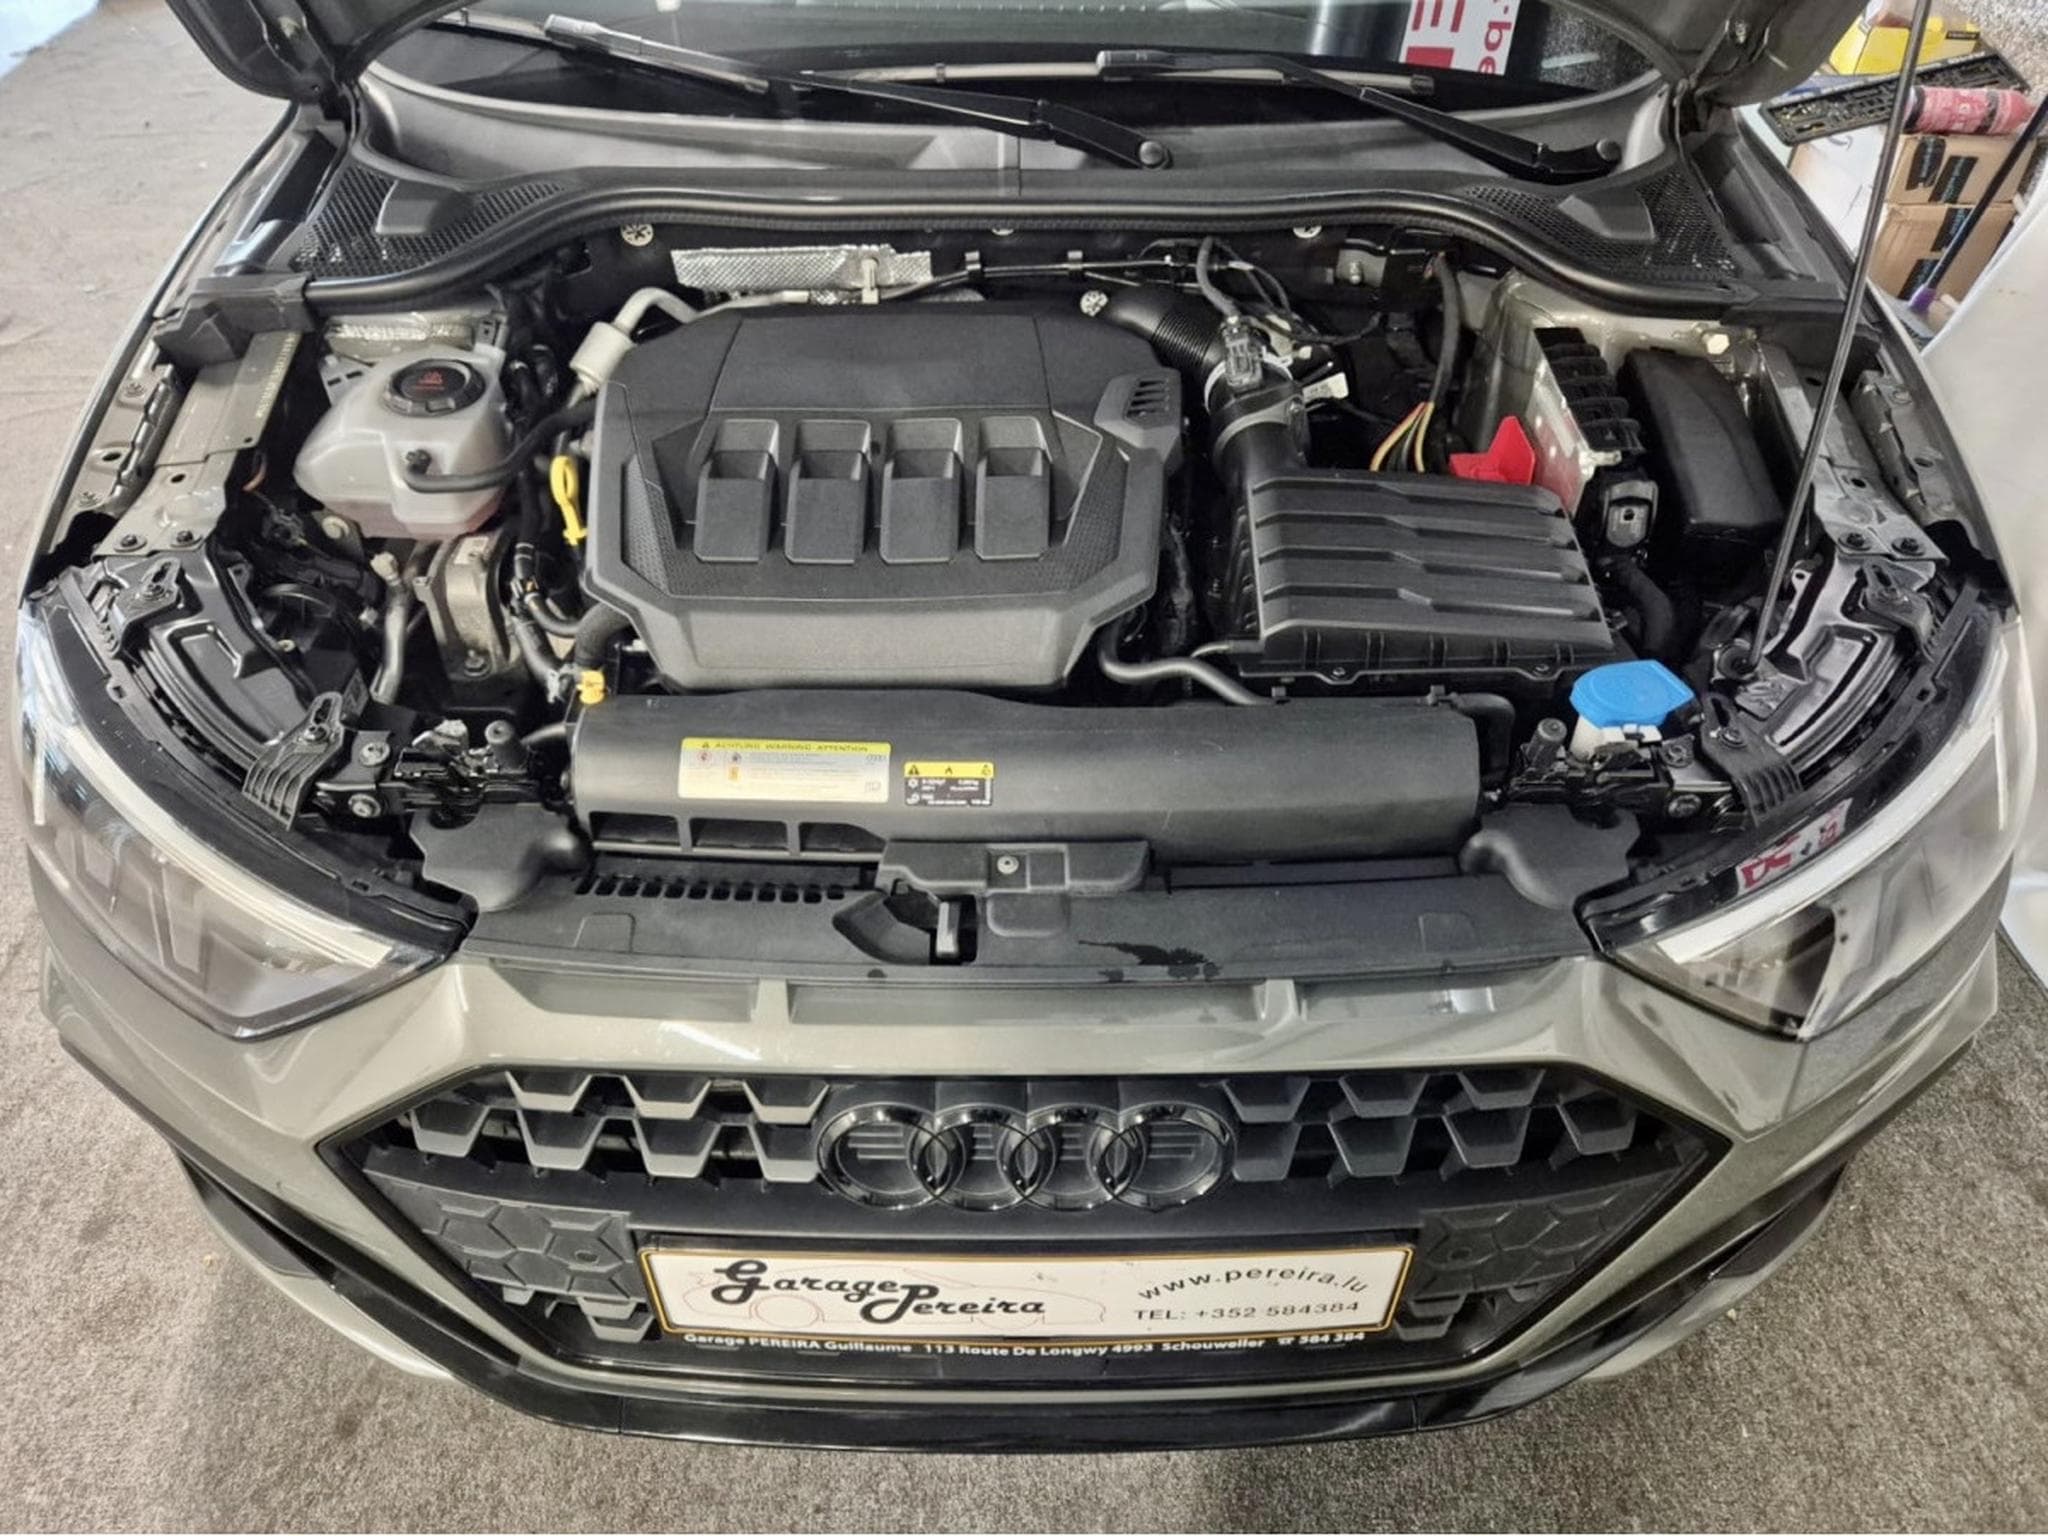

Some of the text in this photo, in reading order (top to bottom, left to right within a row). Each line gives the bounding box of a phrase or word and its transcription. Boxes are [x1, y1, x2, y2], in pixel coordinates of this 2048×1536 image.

[711, 1259, 899, 1305] Garage
[1138, 1266, 1368, 1300] www.pereira.lu
[860, 1284, 1045, 1324] Pereira
[1134, 1301, 1359, 1321] TEL: +352 584384
[683, 1333, 746, 1347] Garage
[749, 1337, 821, 1350] PEREIRA
[824, 1340, 913, 1353] Guillaume
[959, 1344, 1009, 1356] Route
[1013, 1345, 1037, 1356] De
[1040, 1344, 1108, 1356] Longwy
